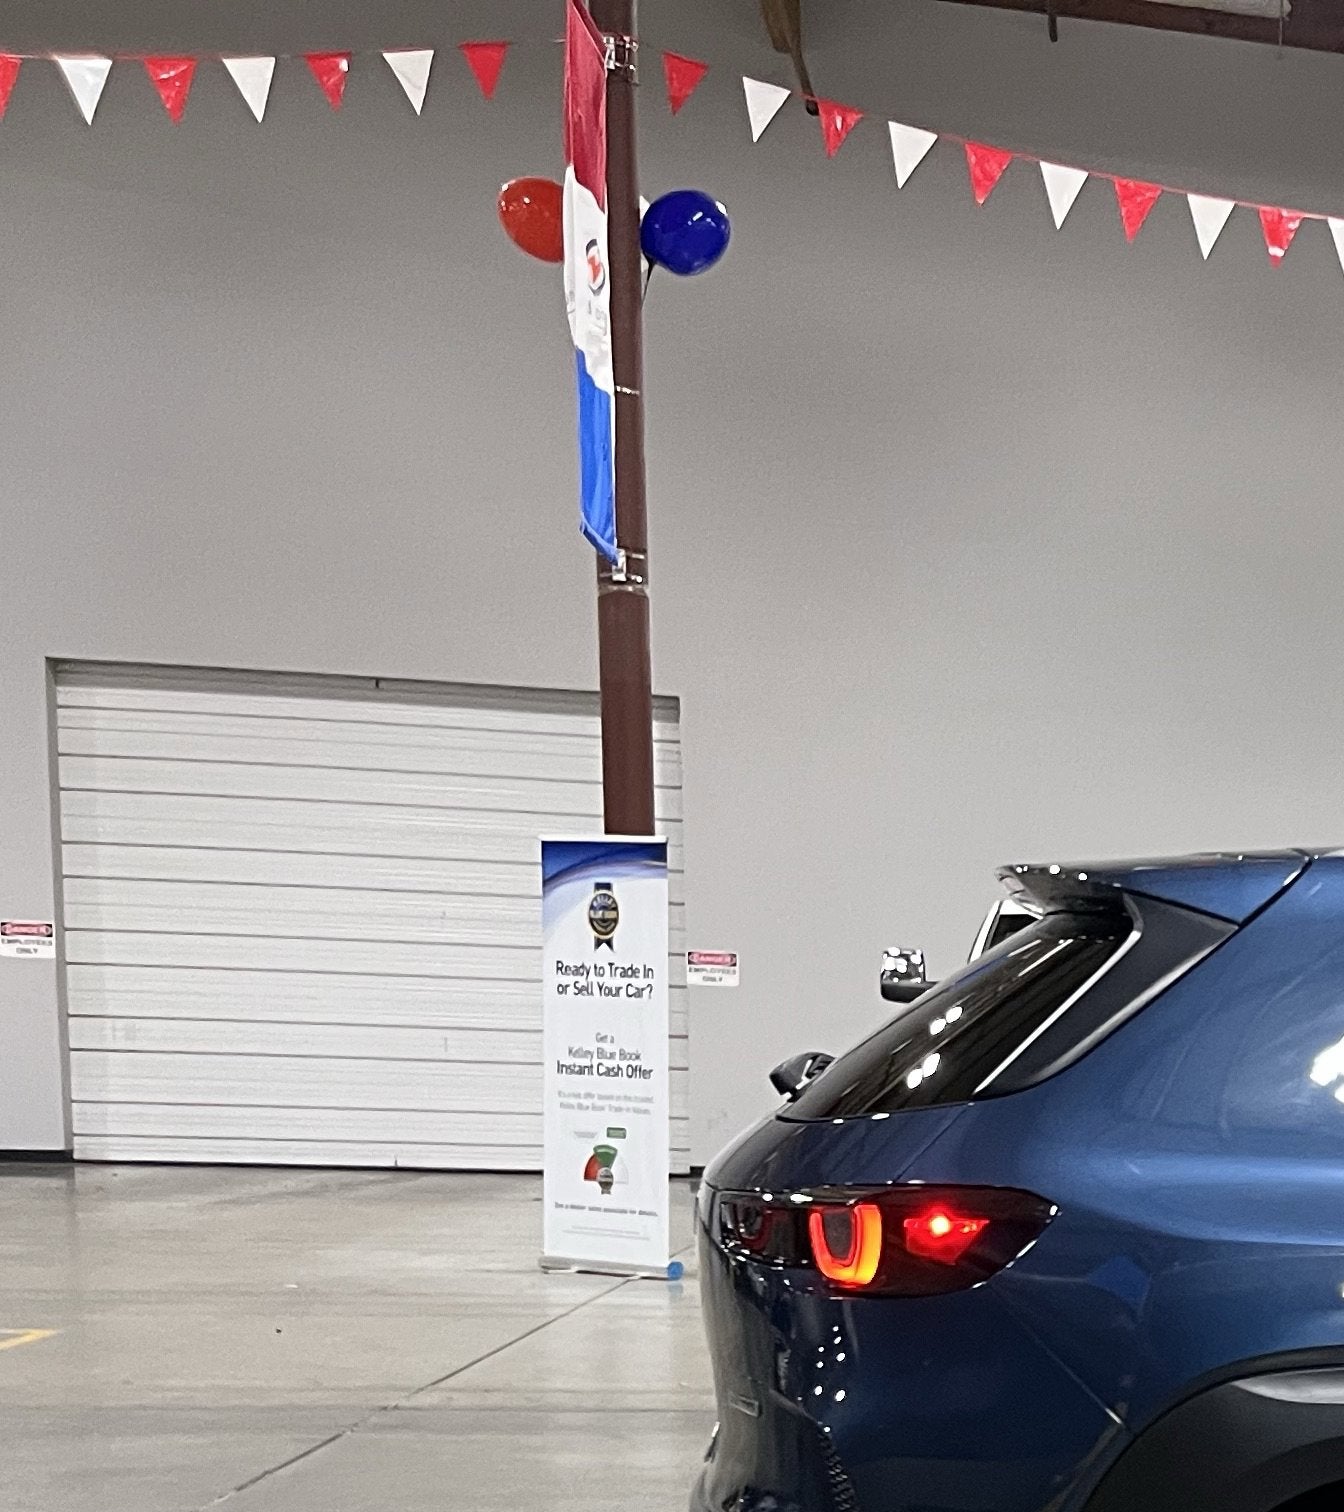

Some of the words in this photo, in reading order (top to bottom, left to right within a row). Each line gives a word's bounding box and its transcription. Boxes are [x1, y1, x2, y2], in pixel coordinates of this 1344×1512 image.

[556, 960, 592, 981] Ready
[594, 963, 606, 978] to
[608, 962, 641, 979] Trade
[643, 964, 655, 979] In
[557, 983, 571, 996] or
[573, 980, 595, 997] Sell
[597, 981, 624, 998] Your
[625, 983, 654, 999] Car?
[557, 1060, 595, 1076] Instant
[597, 1062, 624, 1078] Cash
[625, 1064, 654, 1080] Offer
